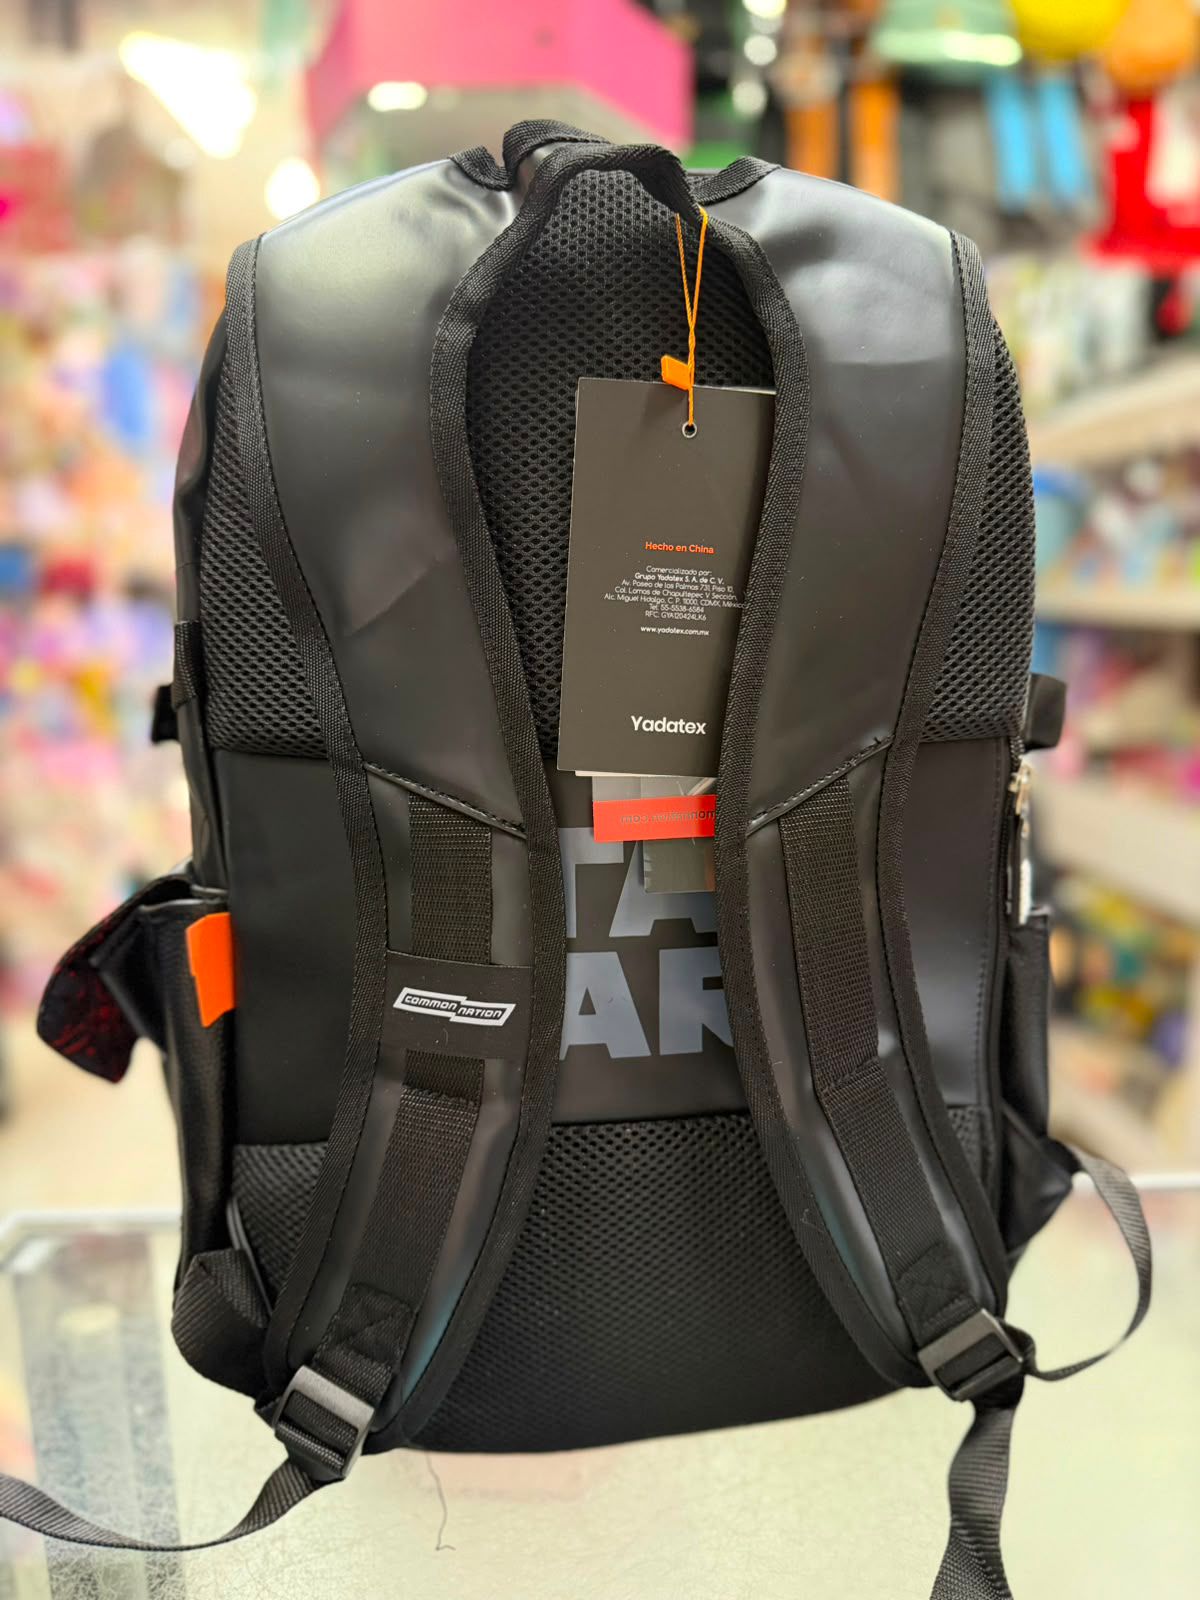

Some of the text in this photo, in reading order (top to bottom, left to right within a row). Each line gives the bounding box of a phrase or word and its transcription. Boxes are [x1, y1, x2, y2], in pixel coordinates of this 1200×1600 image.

[645, 541, 715, 554] Hecho en China
[646, 565, 698, 575] Comercializado
[634, 572, 656, 581] Grupo
[657, 574, 684, 582] Yadatex
[632, 580, 653, 588] Paseo
[654, 581, 664, 589] de
[675, 582, 699, 591] Palmas
[616, 593, 640, 603] Miguel
[628, 587, 651, 595] Lomas
[651, 588, 661, 596] de
[662, 589, 704, 599] Chapultepec
[640, 626, 710, 636] www.yadatex.com.mx
[630, 715, 707, 735] Yadatex
[404, 995, 503, 1019] COMMON NATION
